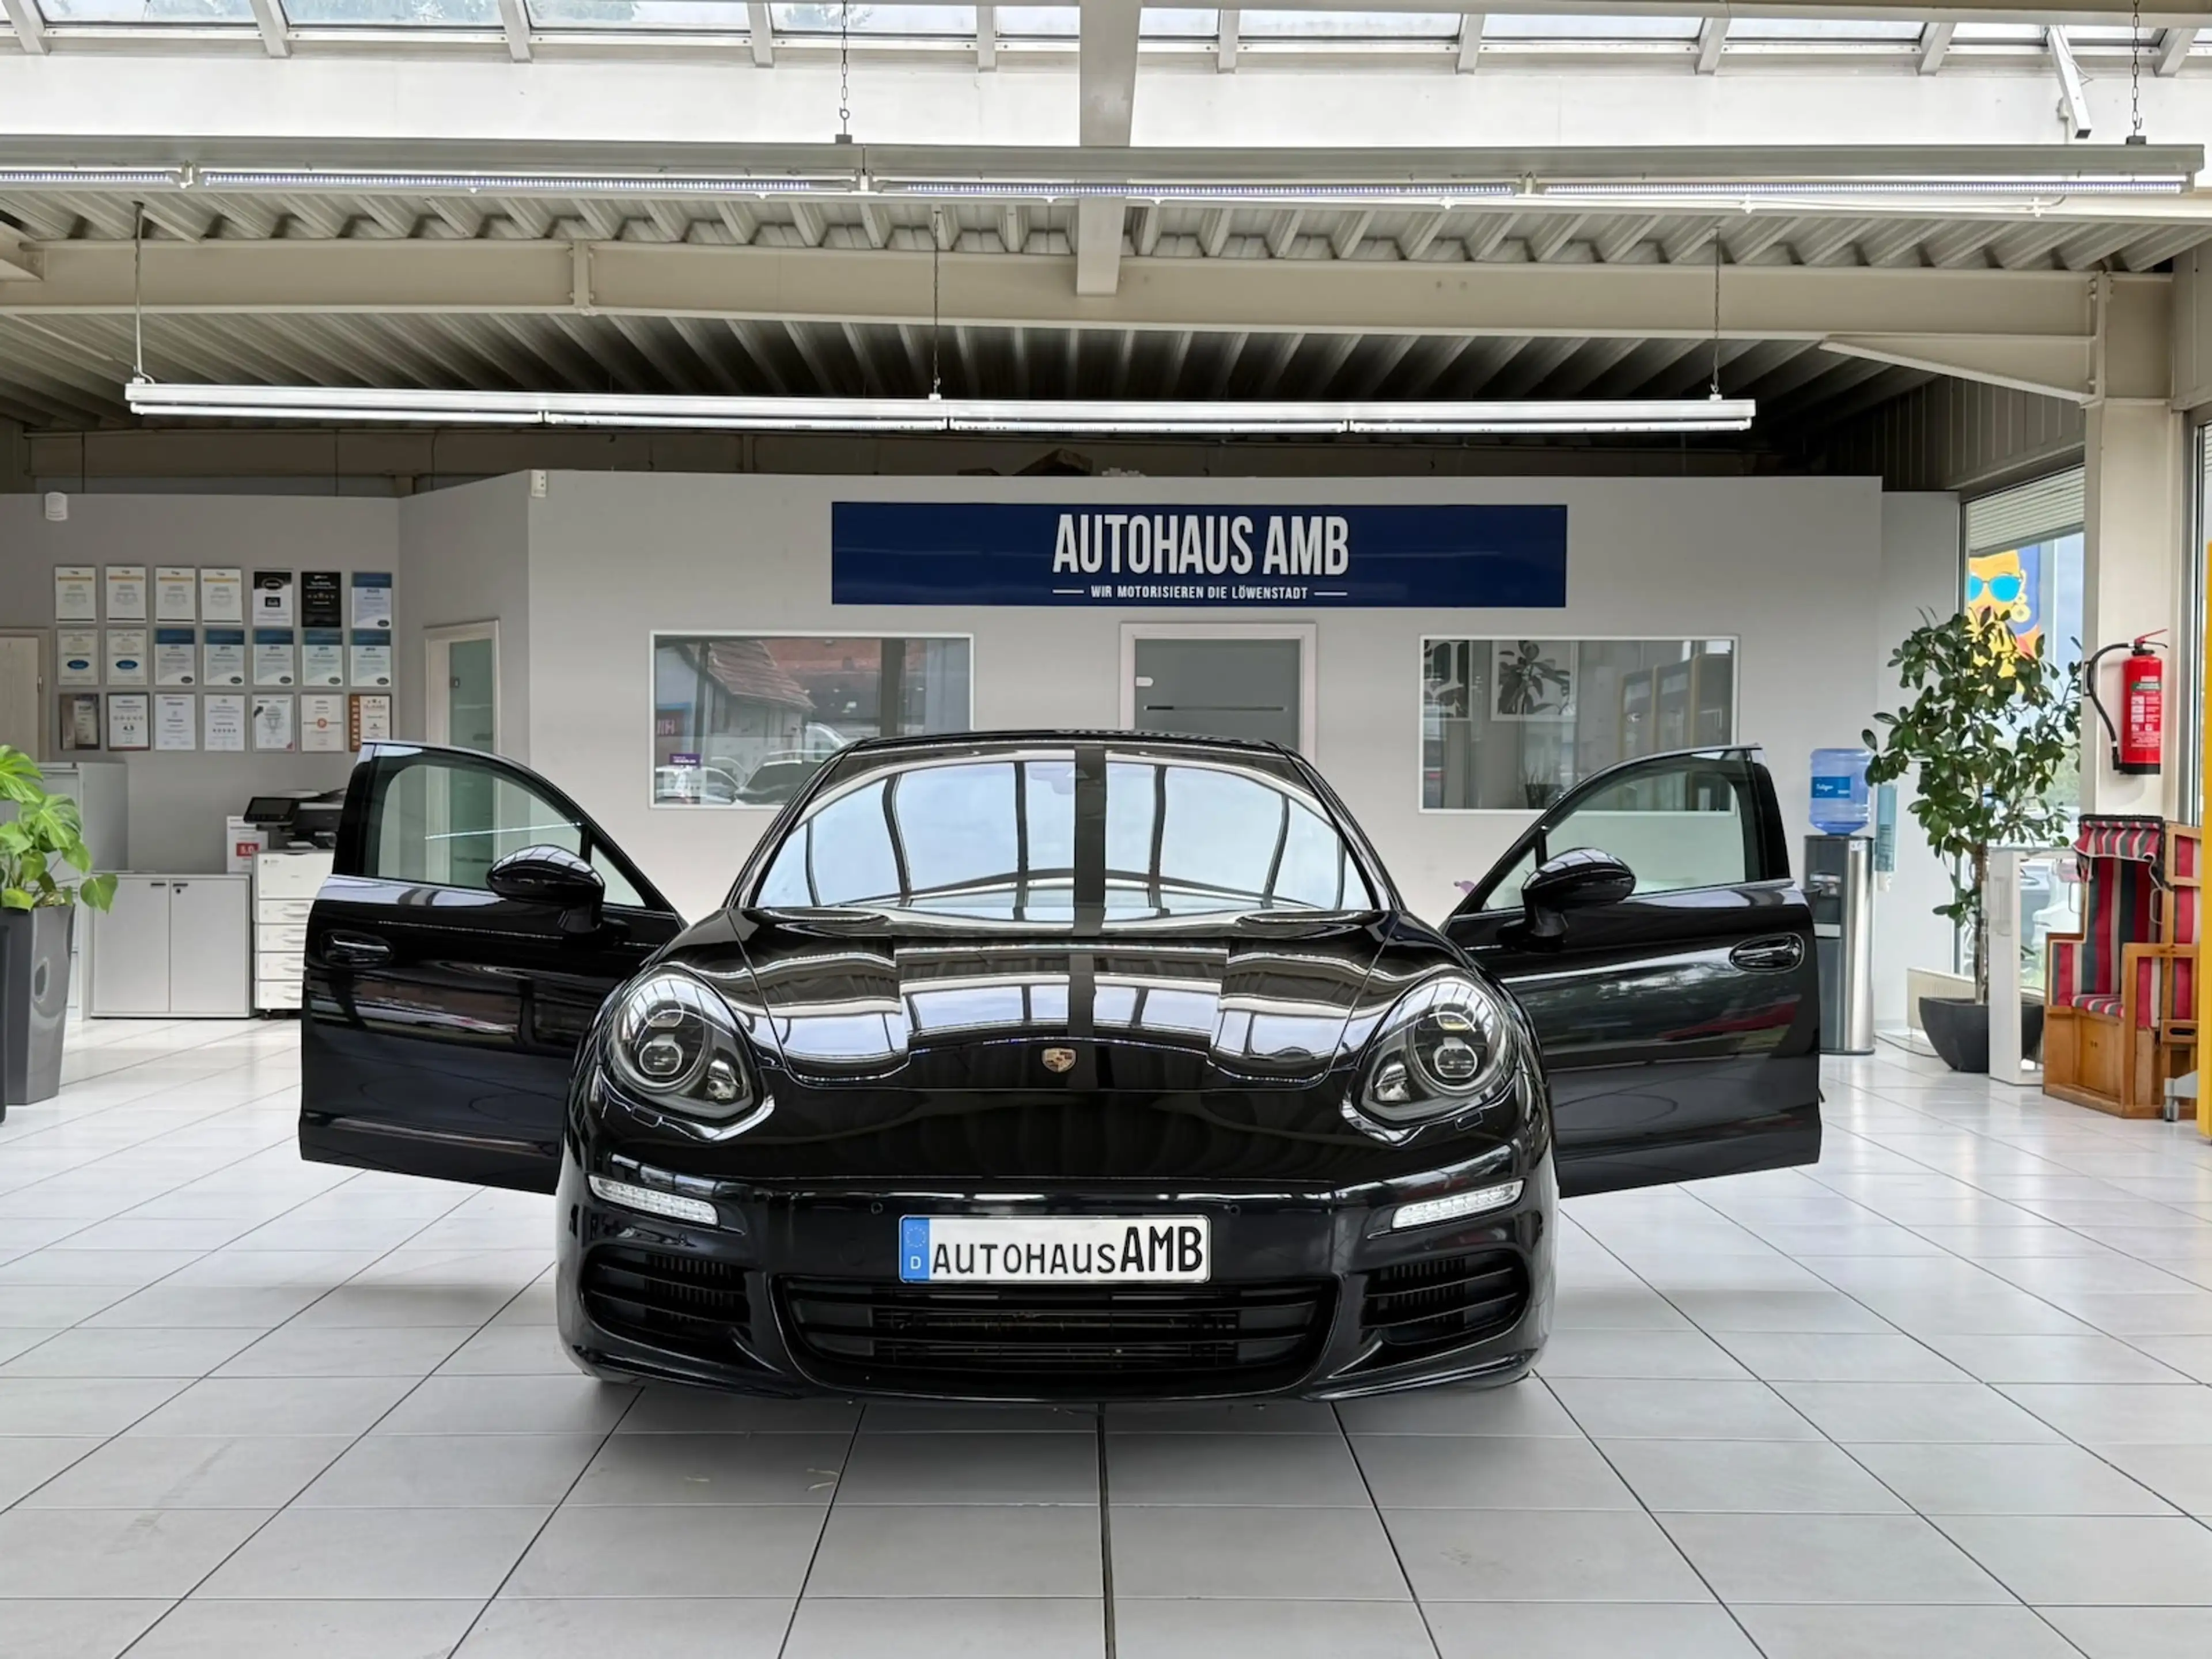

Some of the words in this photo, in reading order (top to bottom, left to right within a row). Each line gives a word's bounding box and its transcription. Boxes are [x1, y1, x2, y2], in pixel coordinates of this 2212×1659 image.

[1052, 514, 1253, 574] AUTOHAUS
[1262, 516, 1349, 575] AMB
[1090, 585, 1112, 598] WIR
[1117, 585, 1204, 599] MOTORISIEREN
[1207, 586, 1228, 599] DIE
[1232, 584, 1308, 600] LÖWENSTADT
[910, 1256, 921, 1270] D
